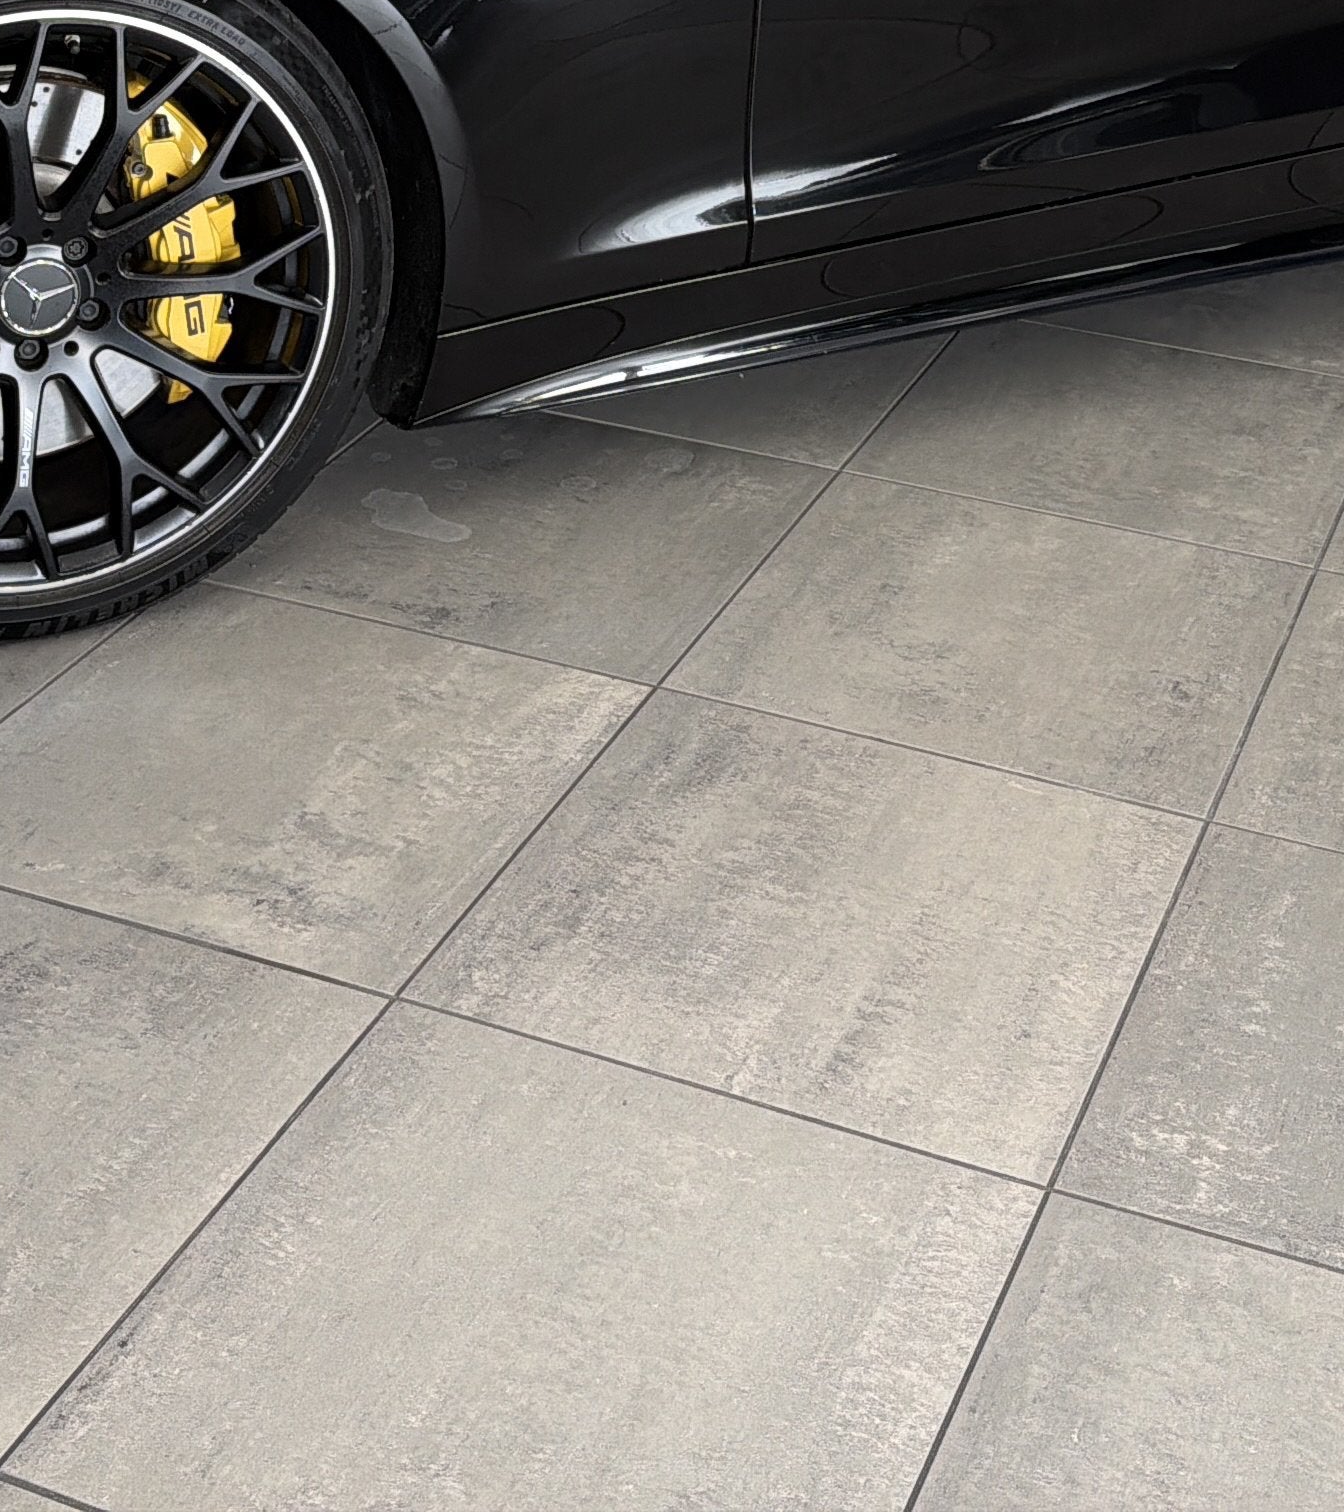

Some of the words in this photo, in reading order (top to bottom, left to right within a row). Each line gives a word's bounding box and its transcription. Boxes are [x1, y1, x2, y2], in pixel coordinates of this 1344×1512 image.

[187, 9, 219, 32] EXTRA
[173, 224, 205, 337] AG
[19, 432, 32, 488] AMG
